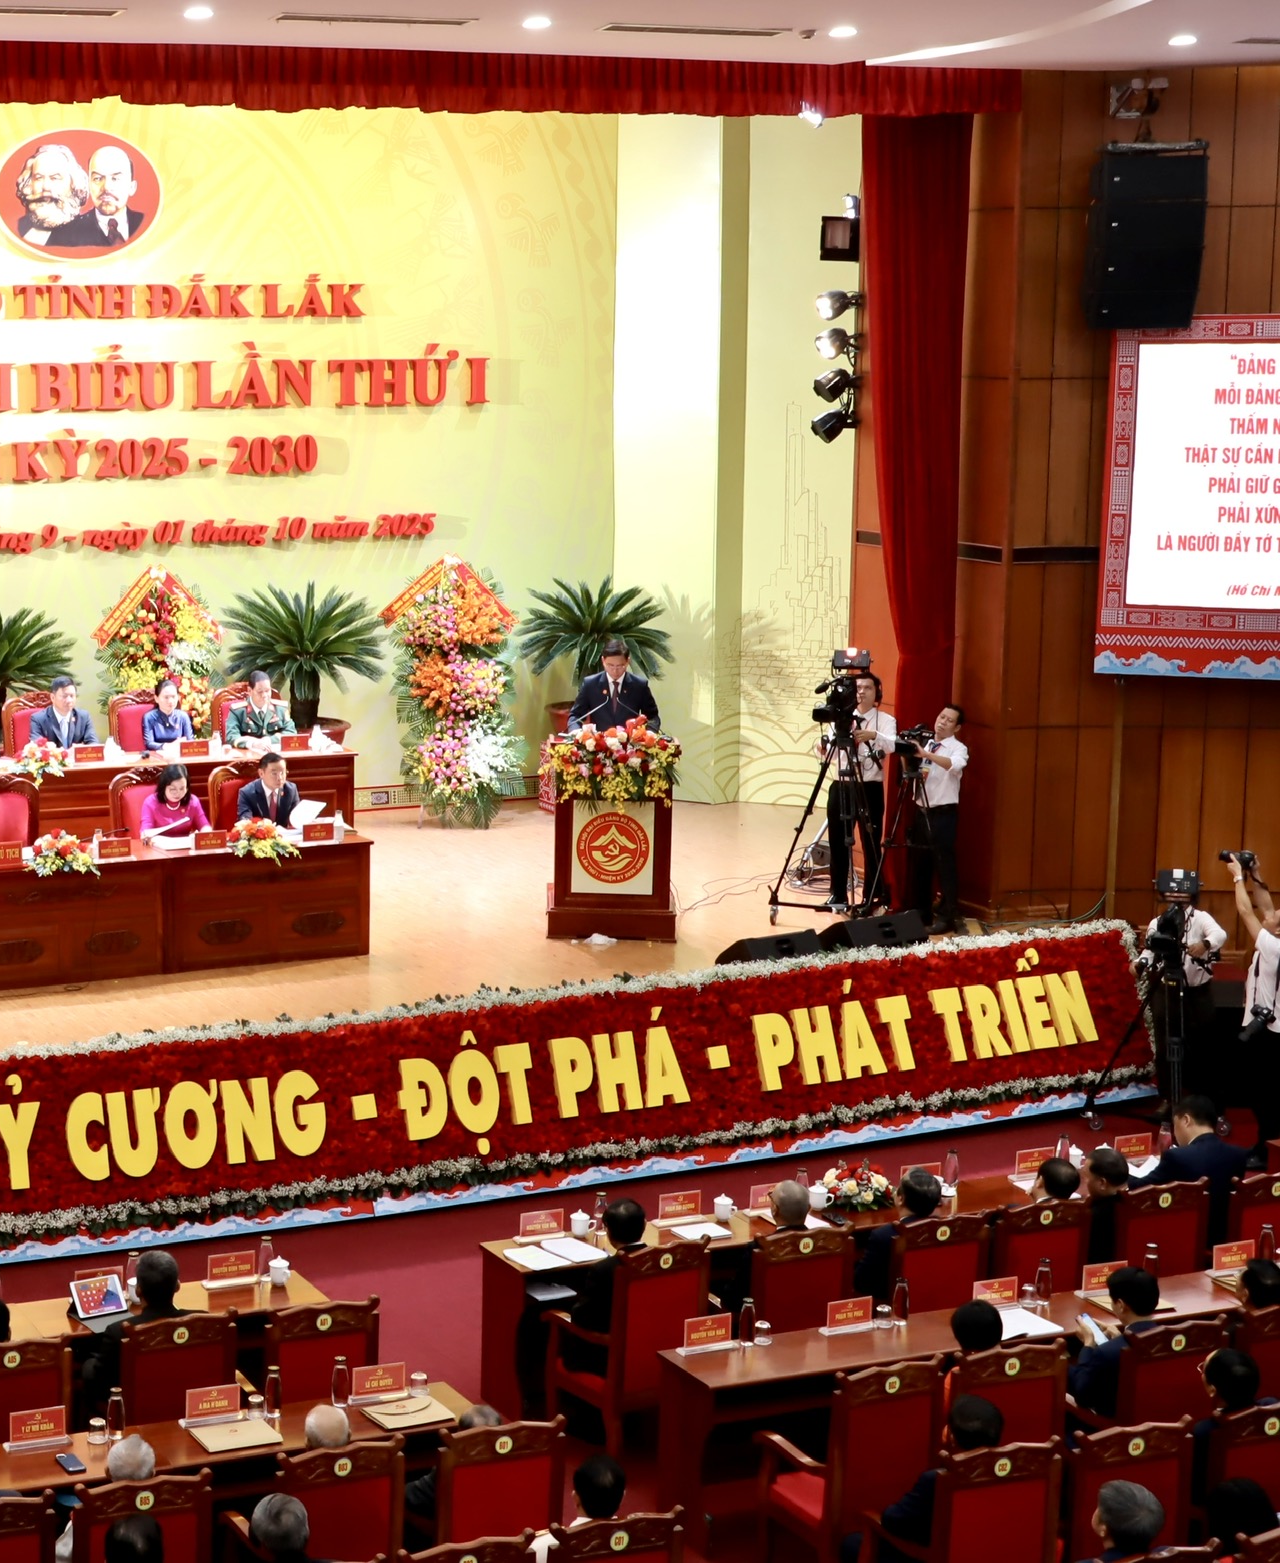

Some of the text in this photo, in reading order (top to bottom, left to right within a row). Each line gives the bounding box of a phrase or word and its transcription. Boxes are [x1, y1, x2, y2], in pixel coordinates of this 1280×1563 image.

[13, 274, 135, 320] TỈNH
[145, 274, 250, 320] ĐẮK
[261, 272, 366, 318] LẮK
[31, 345, 177, 414] BIỂU
[192, 341, 314, 411] LẦN
[326, 345, 458, 408] THỨ
[465, 357, 491, 406] I
[1215, 382, 1241, 405] MỖI
[1230, 412, 1268, 435] THẤM
[15, 429, 92, 484] KỲ
[96, 437, 189, 480] 2025
[228, 434, 319, 477] 2030
[1209, 471, 1241, 494] PHẢI
[1245, 475, 1270, 494] GIỮ
[1218, 501, 1250, 523] PHẢI
[40, 524, 58, 548] 9
[82, 522, 148, 551] ngày
[153, 520, 183, 544] 01
[191, 518, 269, 546] tháng
[272, 516, 307, 539] 10
[311, 516, 370, 538] năm
[372, 512, 437, 538] 2025
[6, 848, 20, 860] TỊCH
[66, 1070, 327, 1181] CƯƠNG
[398, 1032, 533, 1155] ĐỘT
[550, 1005, 691, 1119] PHÁ
[751, 978, 916, 1092] PHÁT
[928, 947, 1100, 1063] TRIỂN
